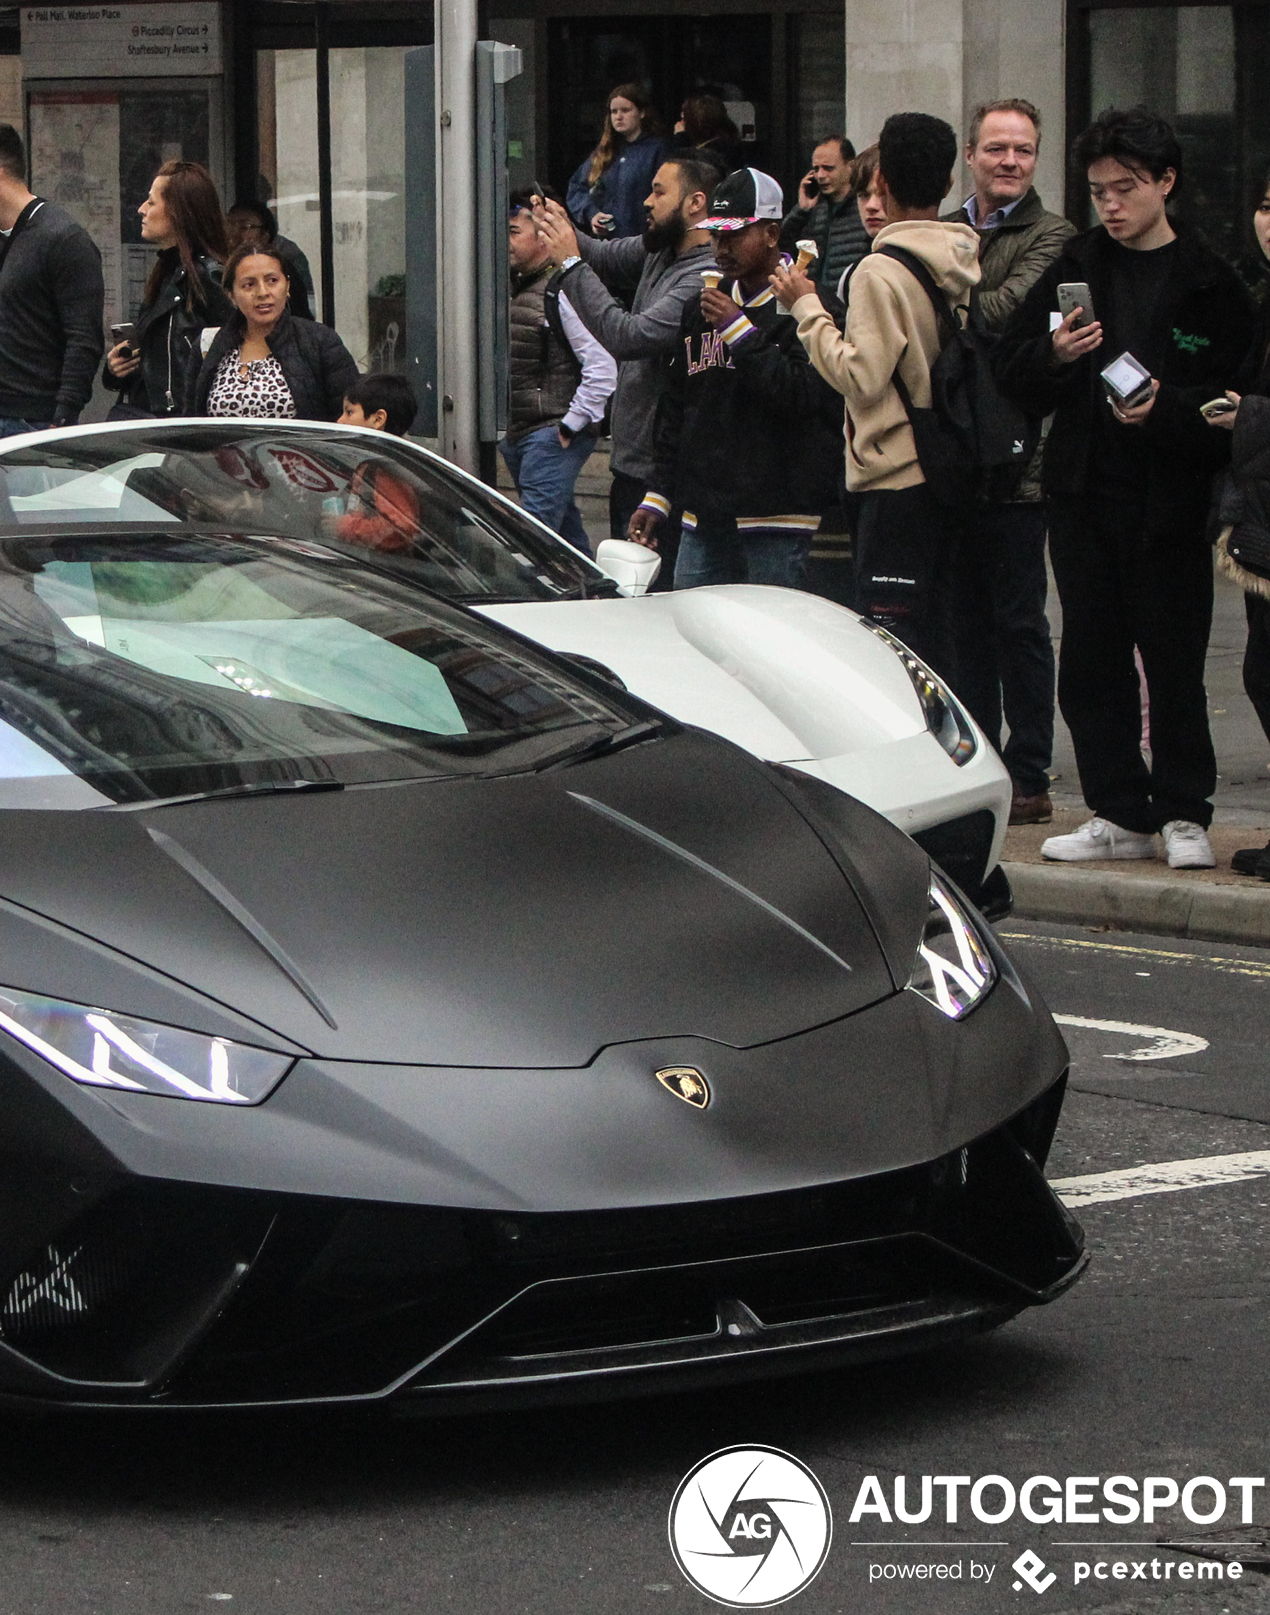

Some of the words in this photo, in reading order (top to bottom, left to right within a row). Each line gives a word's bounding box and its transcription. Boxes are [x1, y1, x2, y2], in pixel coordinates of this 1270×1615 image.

[35, 12, 48, 21] Pall
[68, 10, 100, 20] Waterloo
[102, 9, 121, 19] Place
[140, 26, 174, 37] Piccadilly
[176, 25, 199, 35] Circus
[127, 45, 170, 56] Shaftesbury
[173, 44, 199, 54] Avenue
[685, 329, 736, 376] LAK
